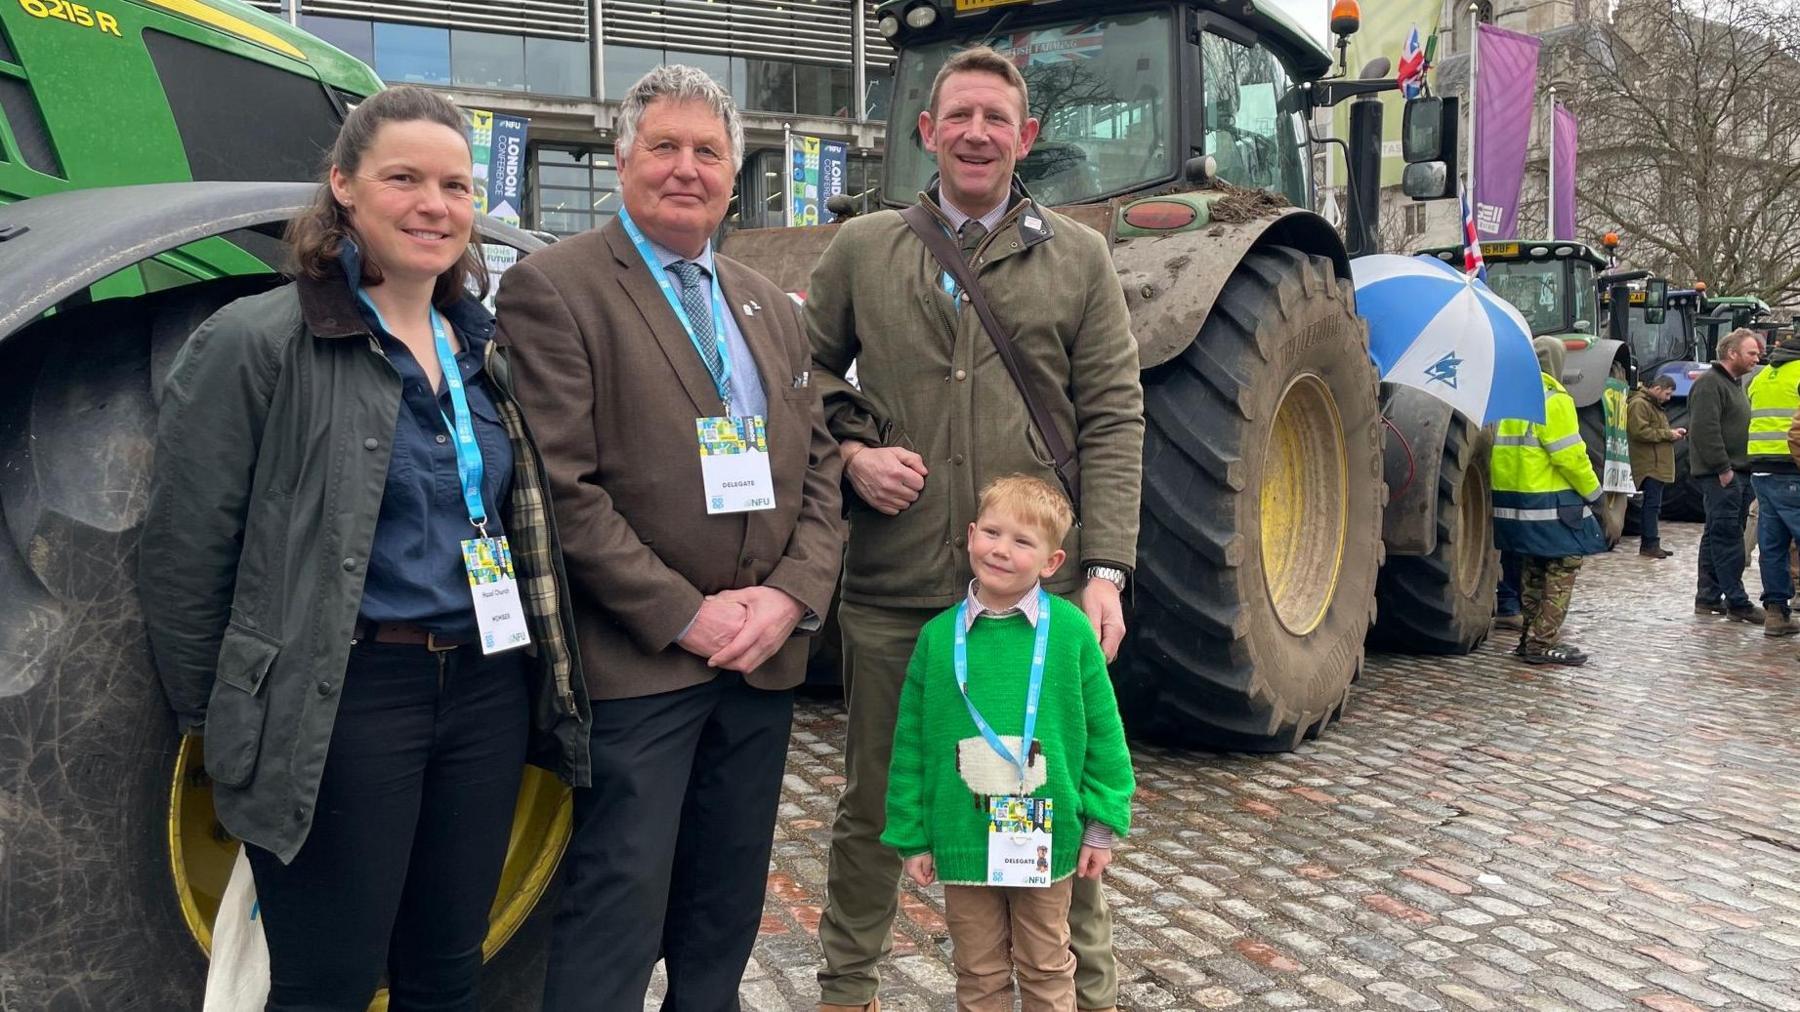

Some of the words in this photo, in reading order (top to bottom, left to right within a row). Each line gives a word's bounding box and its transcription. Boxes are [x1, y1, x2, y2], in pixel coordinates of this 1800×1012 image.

[19, 0, 95, 28] 6215
[95, 11, 123, 37] R
[505, 121, 520, 129] NFU
[495, 135, 506, 195] CONFERENCE
[505, 136, 520, 197] LONDON
[832, 160, 841, 196] LOND
[722, 480, 755, 488] DELEGATE
[751, 498, 770, 507] NFU
